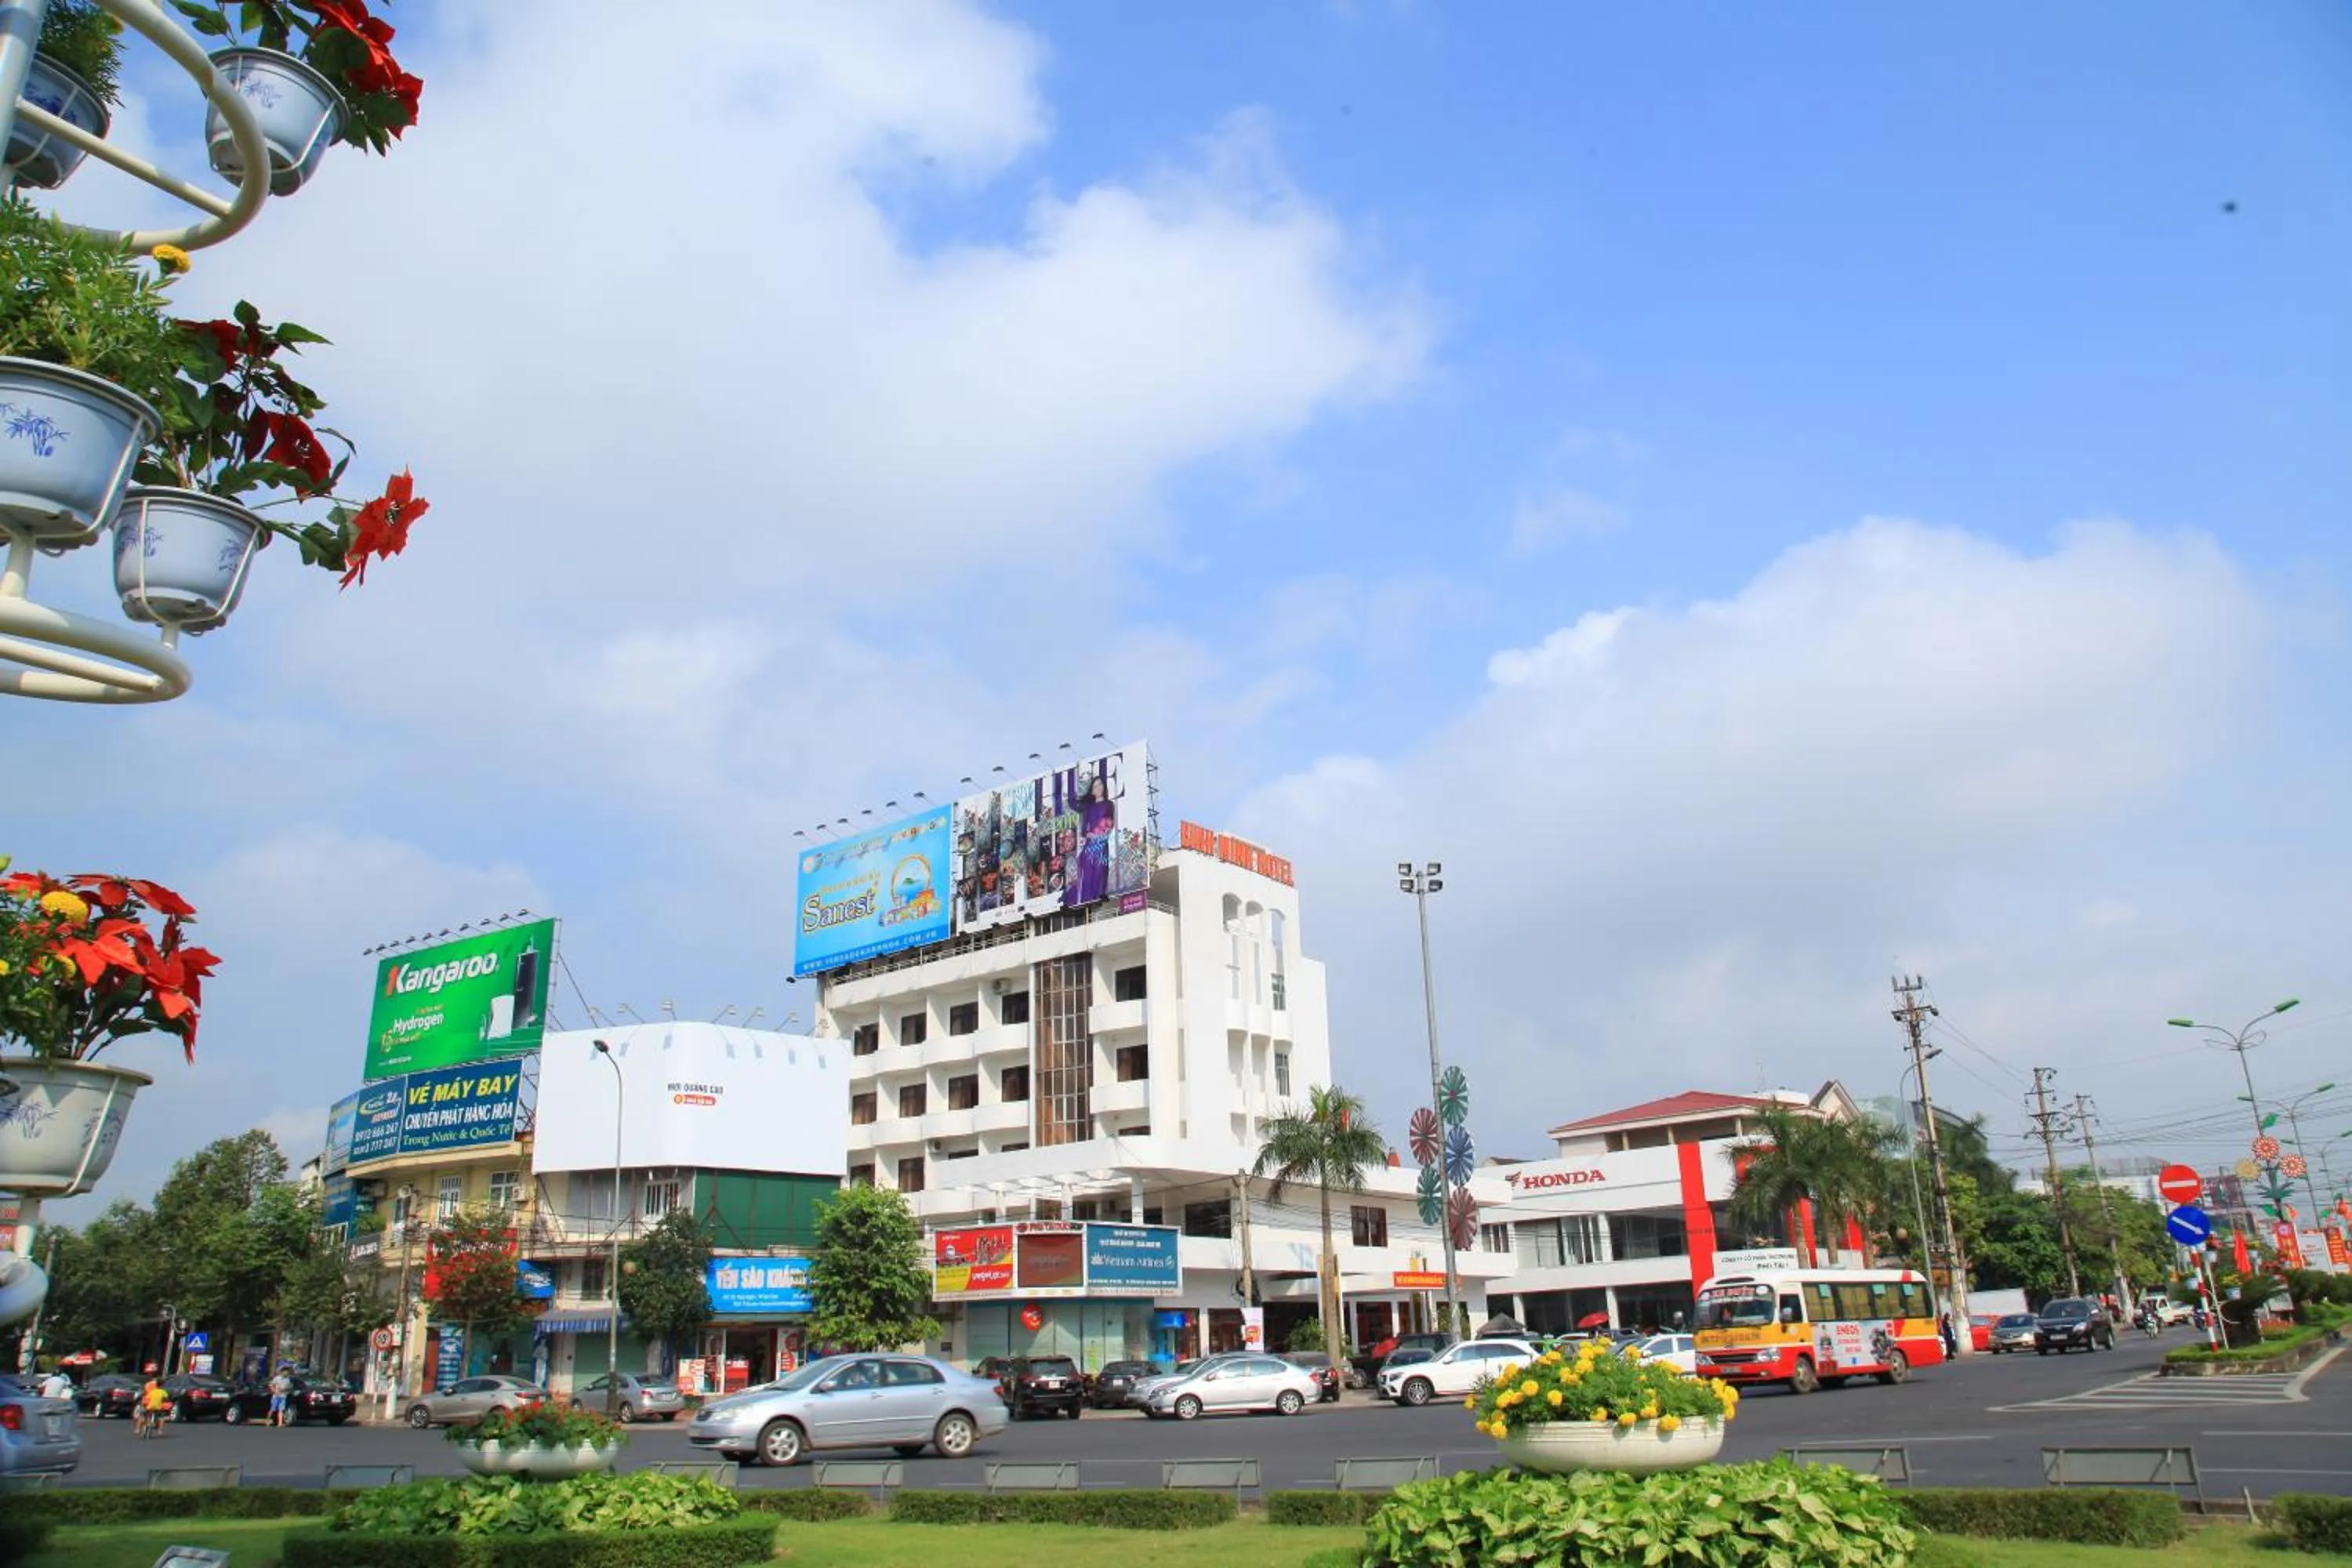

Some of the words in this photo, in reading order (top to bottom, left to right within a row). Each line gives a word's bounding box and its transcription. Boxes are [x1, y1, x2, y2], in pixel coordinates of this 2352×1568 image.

[803, 890, 876, 931] Sanest
[387, 953, 496, 996] Kangaroo
[393, 1012, 444, 1036] Hydrogen
[408, 1081, 430, 1105] VÉ
[432, 1076, 474, 1102] MÁY
[476, 1074, 517, 1096] BAY
[459, 1128, 469, 1139] &
[1523, 1169, 1606, 1189] HONDA
[716, 1261, 739, 1290] YẾN
